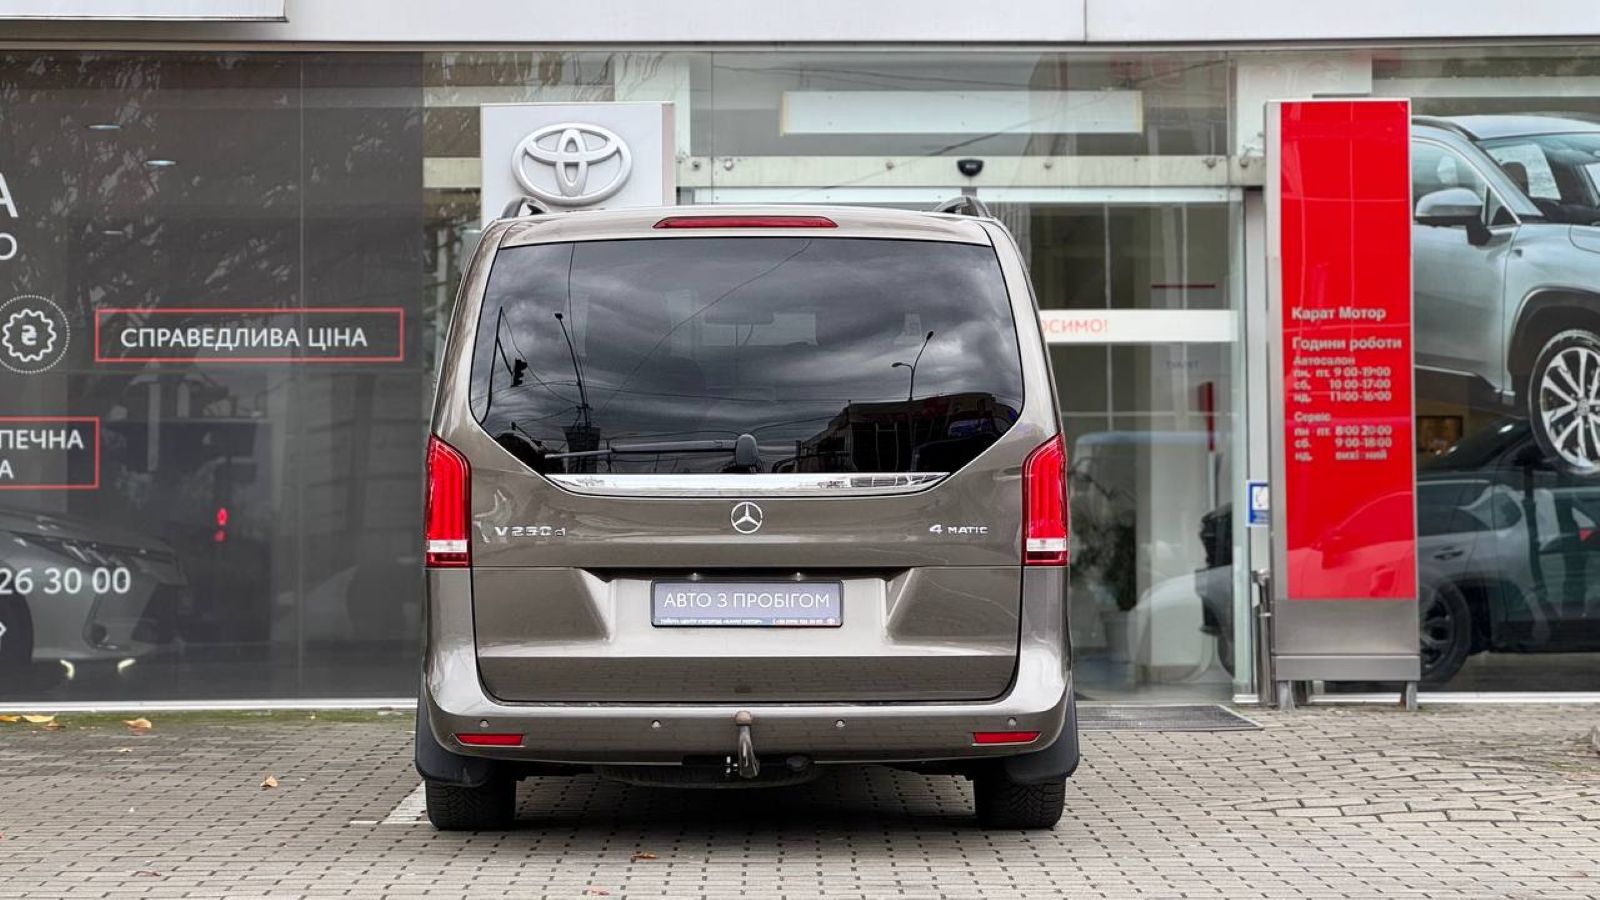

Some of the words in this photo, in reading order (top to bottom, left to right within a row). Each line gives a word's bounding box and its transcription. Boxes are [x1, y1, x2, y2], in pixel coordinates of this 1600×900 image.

[1291, 306, 1336, 323] Карат
[1338, 306, 1387, 322] Мотор
[120, 327, 300, 351] СПРАВЕДЛИВА
[307, 328, 368, 351] ЦІНА
[1291, 336, 1347, 352] Години
[1349, 335, 1403, 353] роботи
[929, 524, 943, 534] 4
[947, 526, 989, 534] MATIC
[0, 567, 34, 595] 26
[43, 567, 82, 595] 30
[92, 567, 131, 595] 00
[664, 593, 712, 608] АВТО
[733, 592, 830, 608] ПРОБІГОМ
